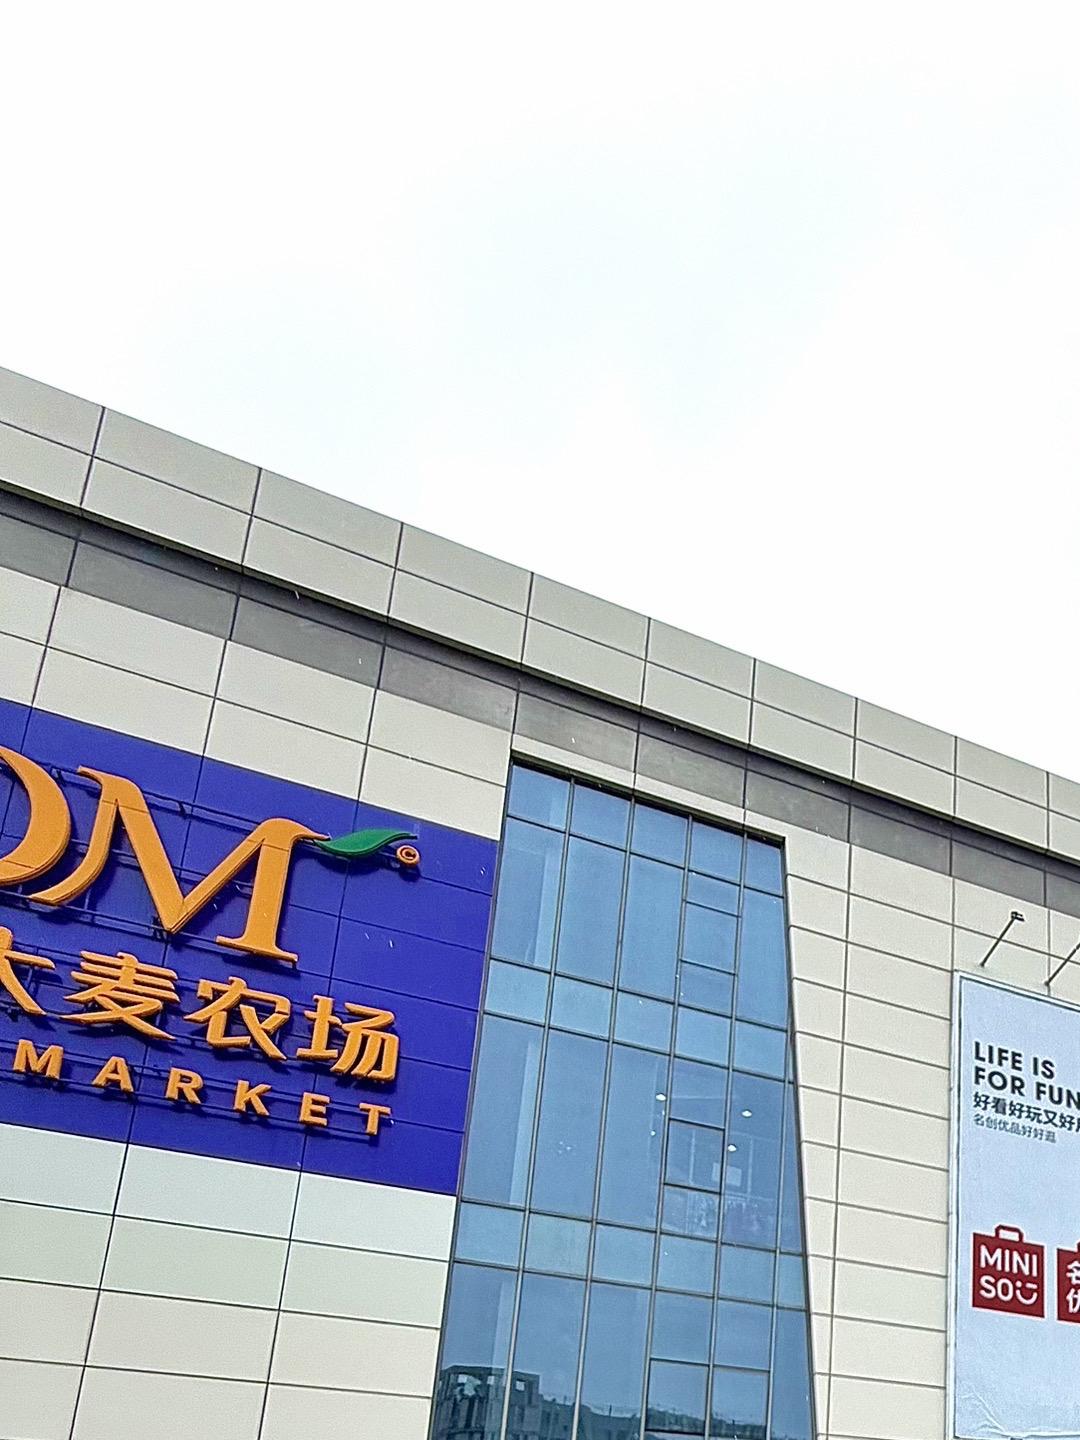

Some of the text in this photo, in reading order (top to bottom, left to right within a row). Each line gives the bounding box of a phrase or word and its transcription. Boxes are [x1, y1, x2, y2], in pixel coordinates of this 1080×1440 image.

[0, 926, 400, 1083] 大麦农场
[974, 1041, 1055, 1080] LIFE IS
[12, 1039, 392, 1137] MARKET
[974, 1065, 1026, 1097] FOR
[980, 1244, 1039, 1278] MINI
